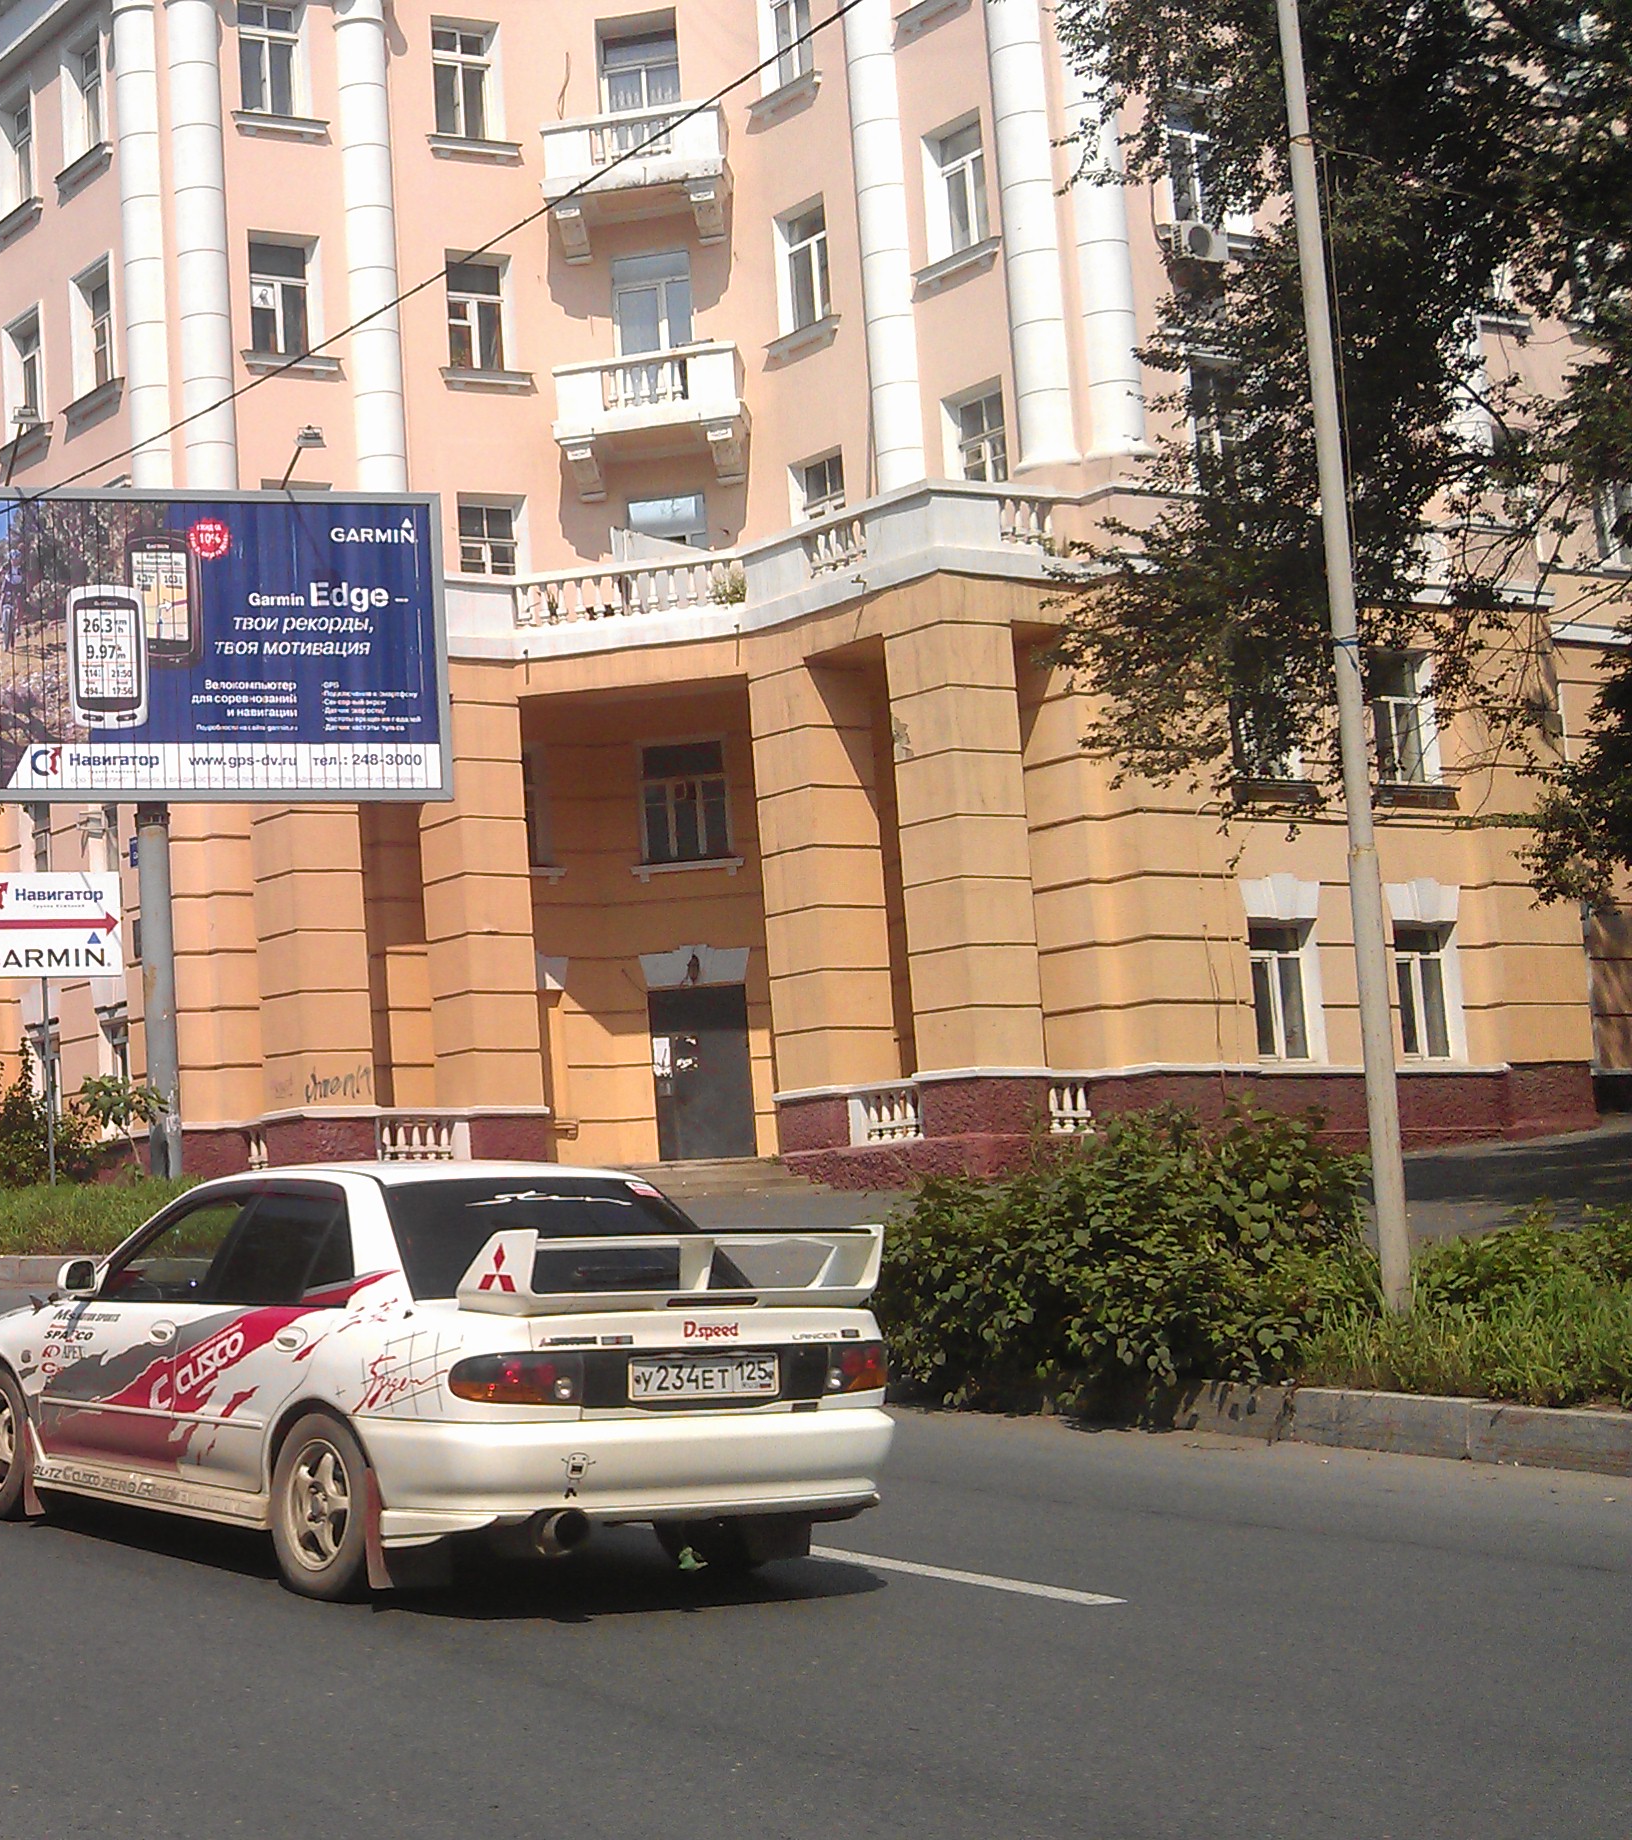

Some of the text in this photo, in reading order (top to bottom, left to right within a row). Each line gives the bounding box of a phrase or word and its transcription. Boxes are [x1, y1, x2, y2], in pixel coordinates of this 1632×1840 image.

[330, 527, 415, 544] GARMIN
[248, 592, 305, 607] Garmin
[309, 581, 390, 613] Edge
[83, 618, 113, 634] 26.3
[233, 616, 375, 635] твои рекорды,
[86, 644, 116, 660] 9.97
[214, 640, 371, 658] твоя мотивация
[204, 679, 298, 692] Велокомпьютер
[191, 694, 213, 705] для
[236, 708, 299, 719] навигации
[69, 752, 160, 769] Навигатор
[188, 754, 299, 769] www.gps-dv.ru
[351, 753, 423, 766] 248-3000
[15, 888, 104, 903] Навигатор
[44, 1330, 95, 1341] SPACO
[683, 1321, 739, 1340] D.speed
[641, 1360, 767, 1391] У234ЕТ 125
